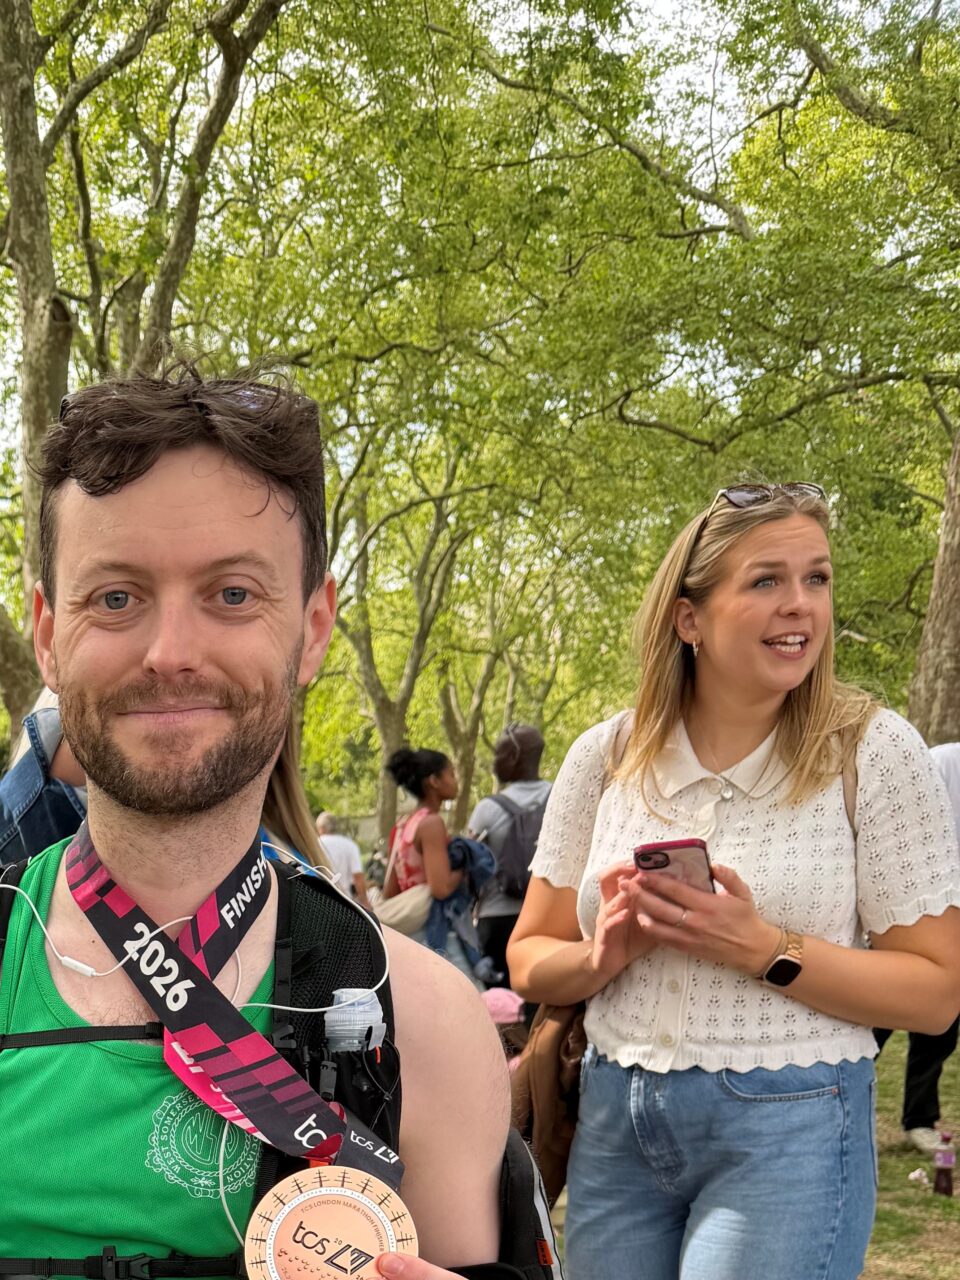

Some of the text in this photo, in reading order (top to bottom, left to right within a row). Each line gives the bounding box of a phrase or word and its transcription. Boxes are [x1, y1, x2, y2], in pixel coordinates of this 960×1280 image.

[123, 922, 196, 1012] 2026
[161, 1094, 201, 1173] WEST SOMERSE
[294, 1113, 327, 1148] tc
[350, 1130, 374, 1150] tcs
[301, 1204, 313, 1214] TCS
[313, 1199, 341, 1209] LONDON
[342, 1200, 376, 1227] MARATHON
[292, 1221, 330, 1255] tcs
